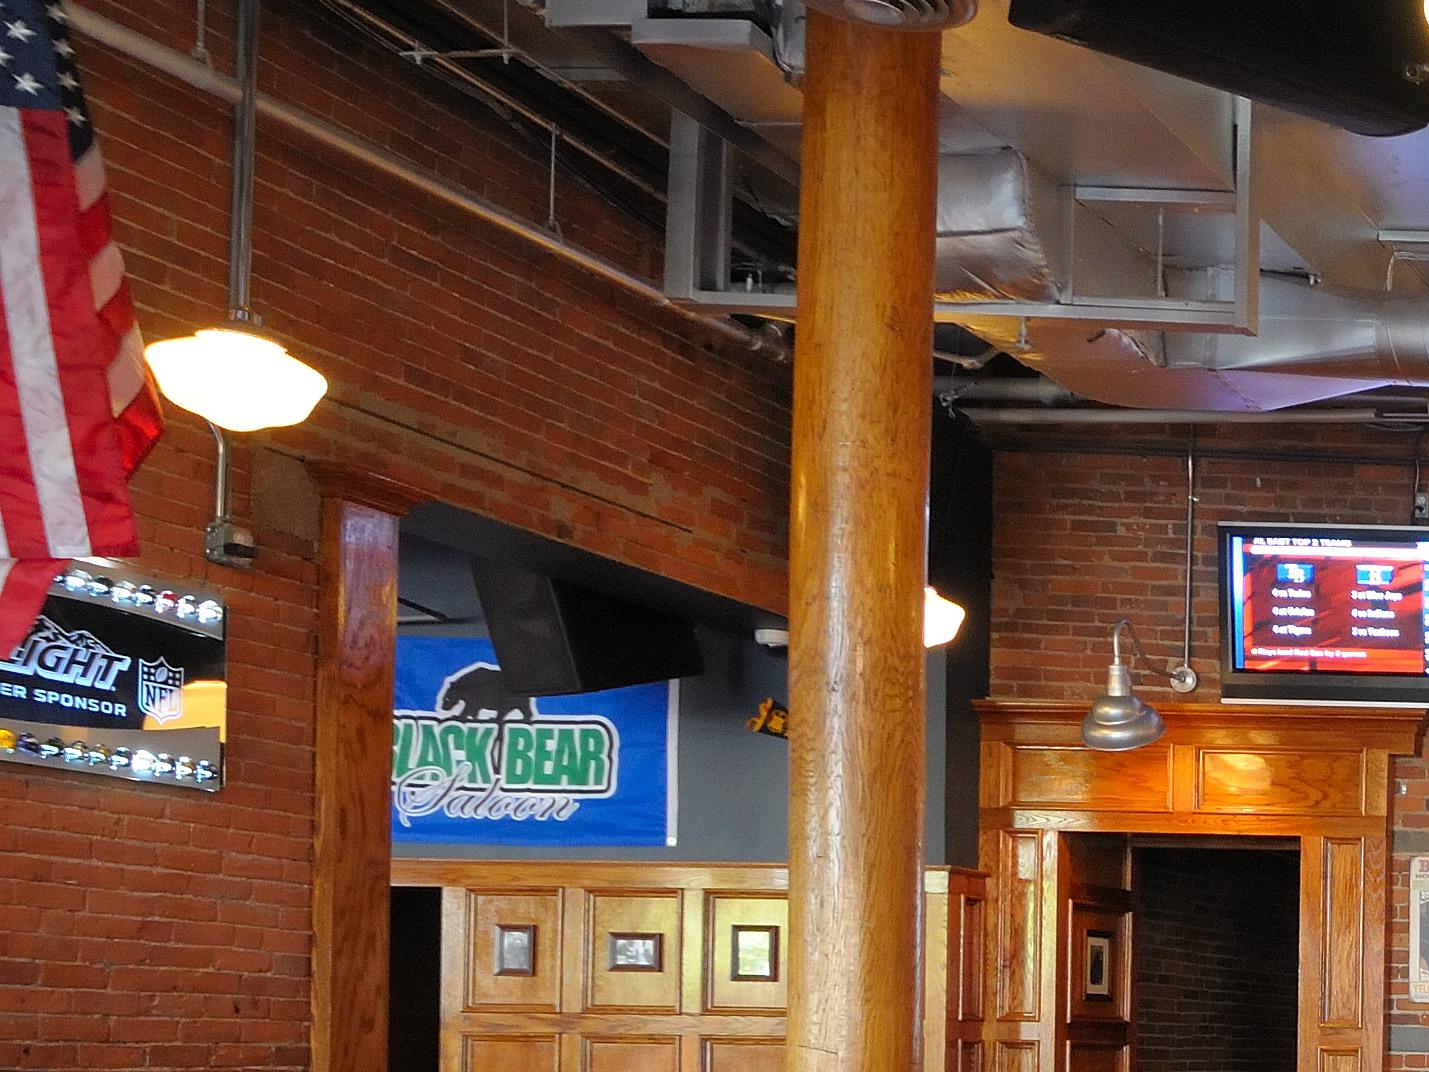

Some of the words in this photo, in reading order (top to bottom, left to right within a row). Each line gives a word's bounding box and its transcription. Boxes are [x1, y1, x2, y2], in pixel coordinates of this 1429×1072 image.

[34, 688, 127, 717] SPONSOR
[143, 682, 179, 713] NFL
[507, 726, 606, 787] BEAR
[396, 760, 581, 828] Saloon
